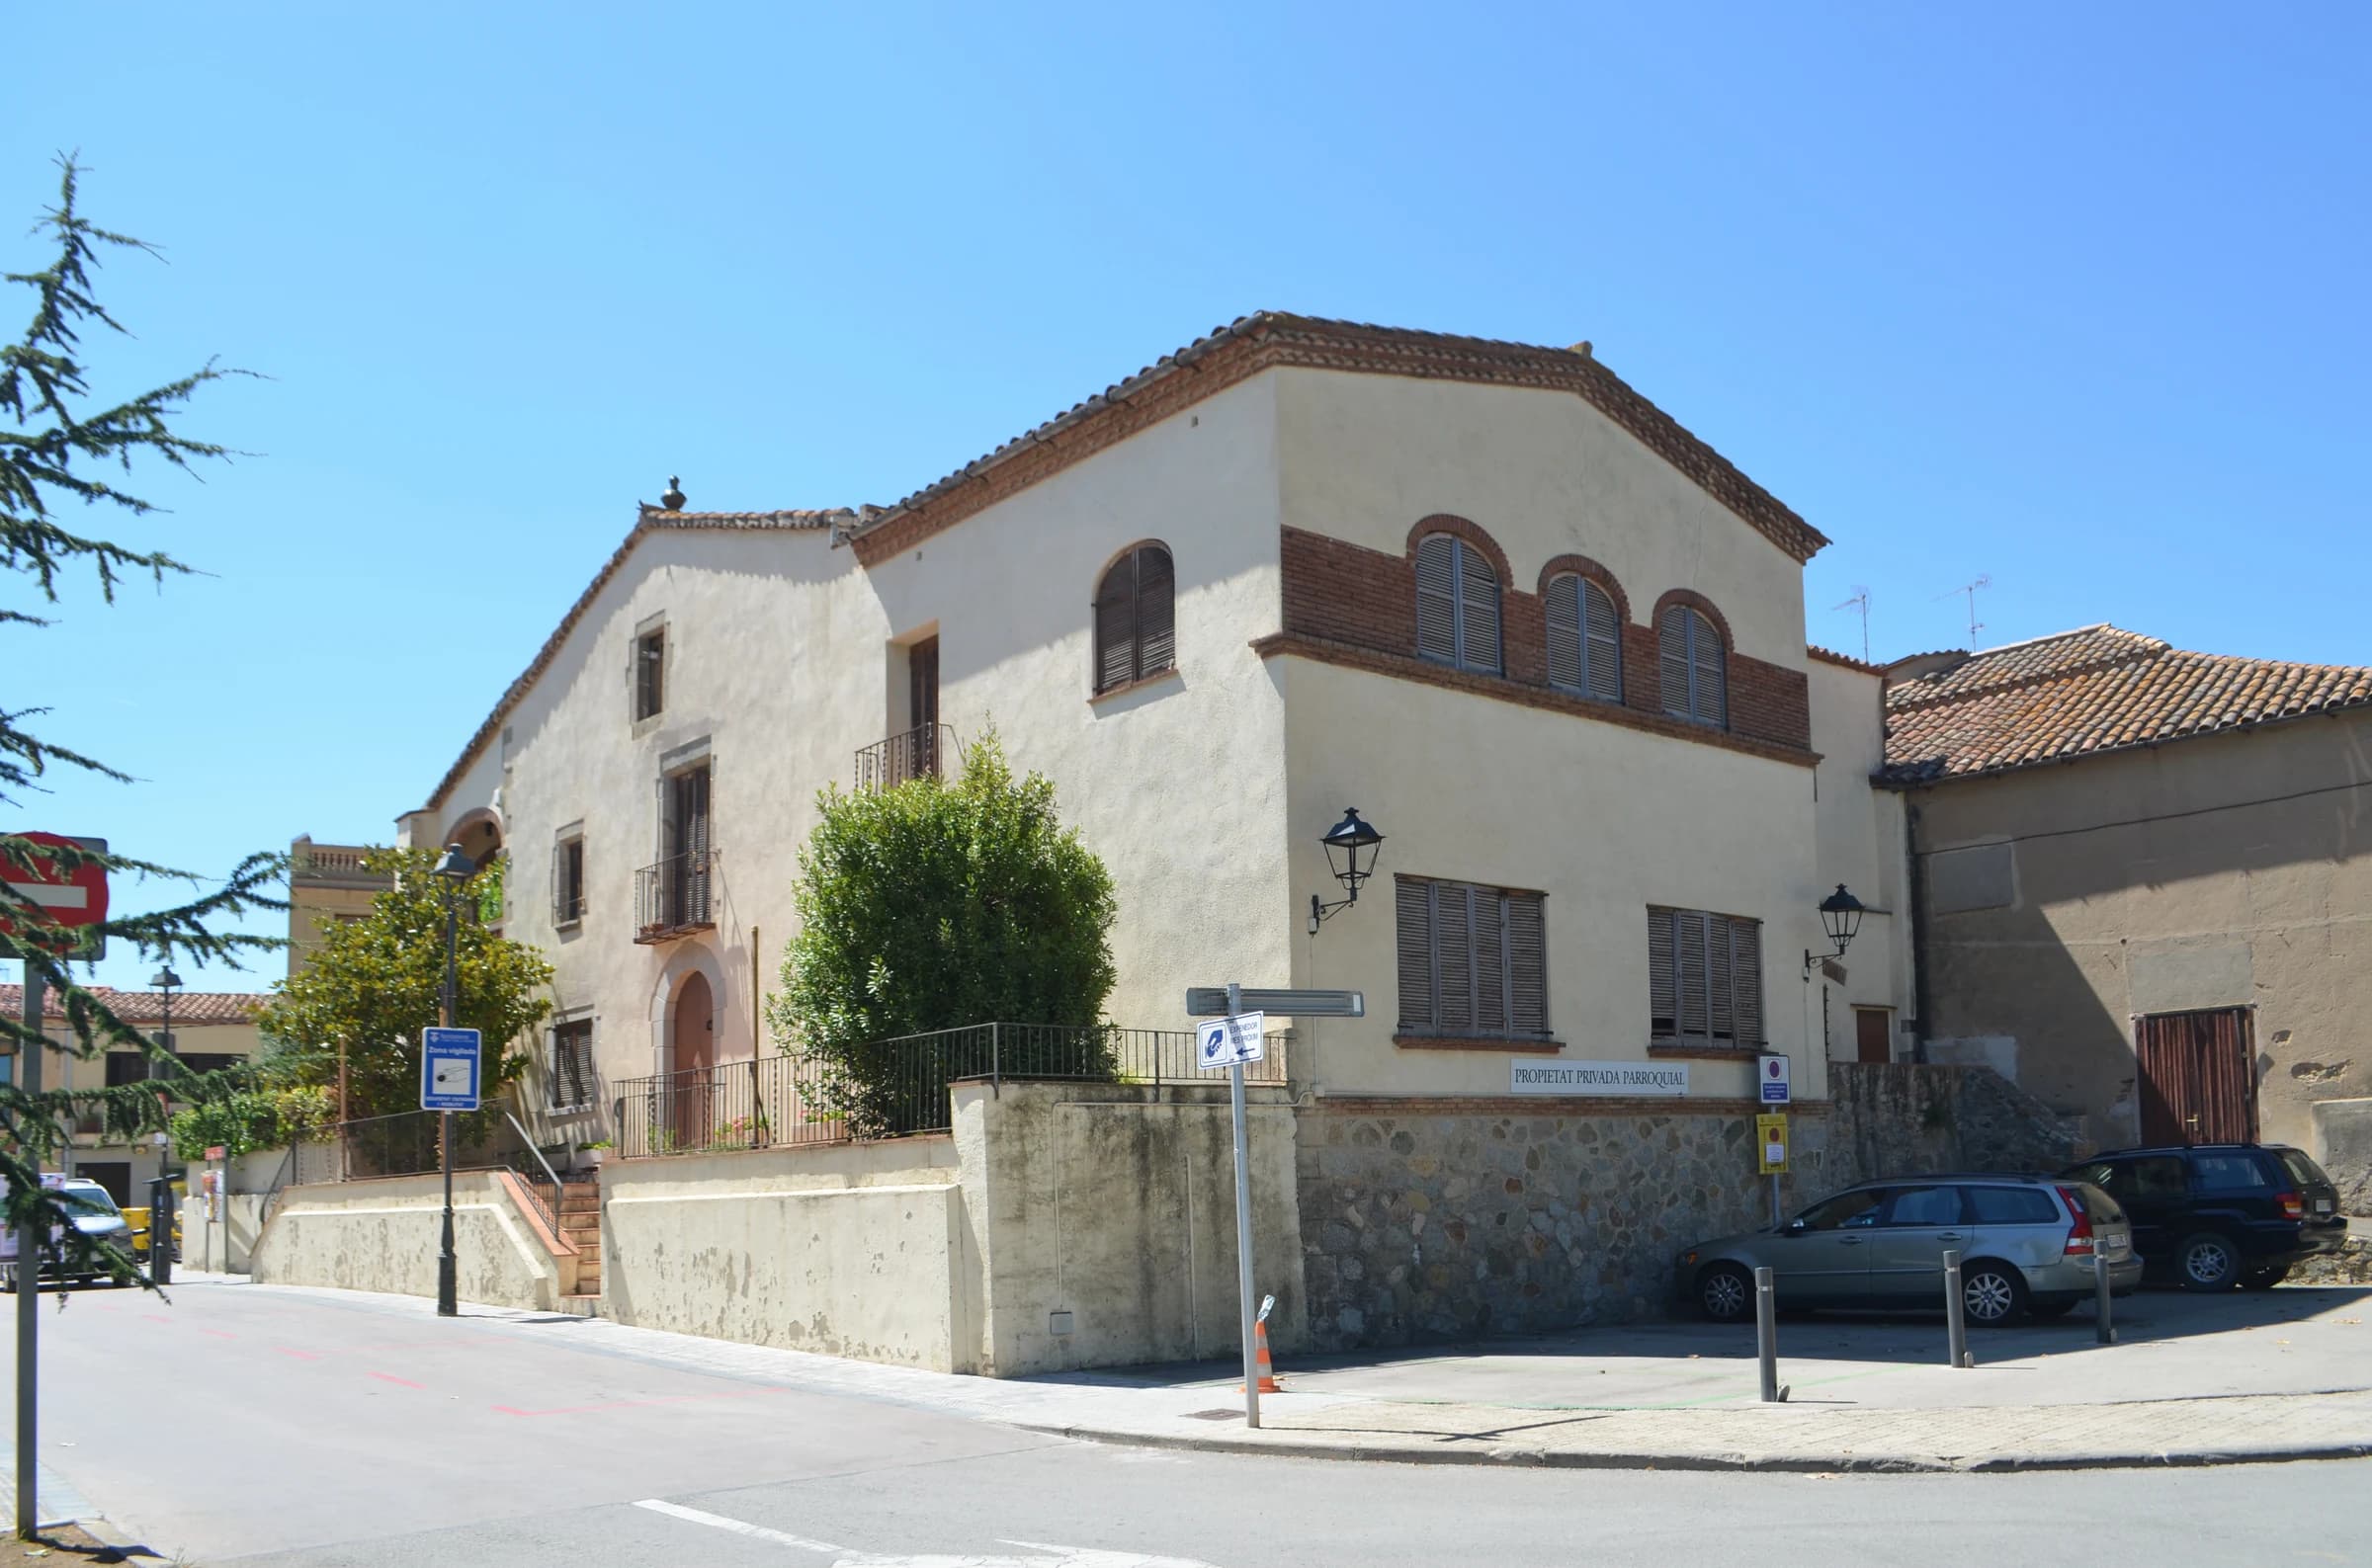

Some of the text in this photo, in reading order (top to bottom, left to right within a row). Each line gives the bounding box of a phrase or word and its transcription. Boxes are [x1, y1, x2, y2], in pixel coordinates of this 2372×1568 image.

[1515, 1068, 1685, 1088] PROPIETAT PRIVADA PARROQUIAL
